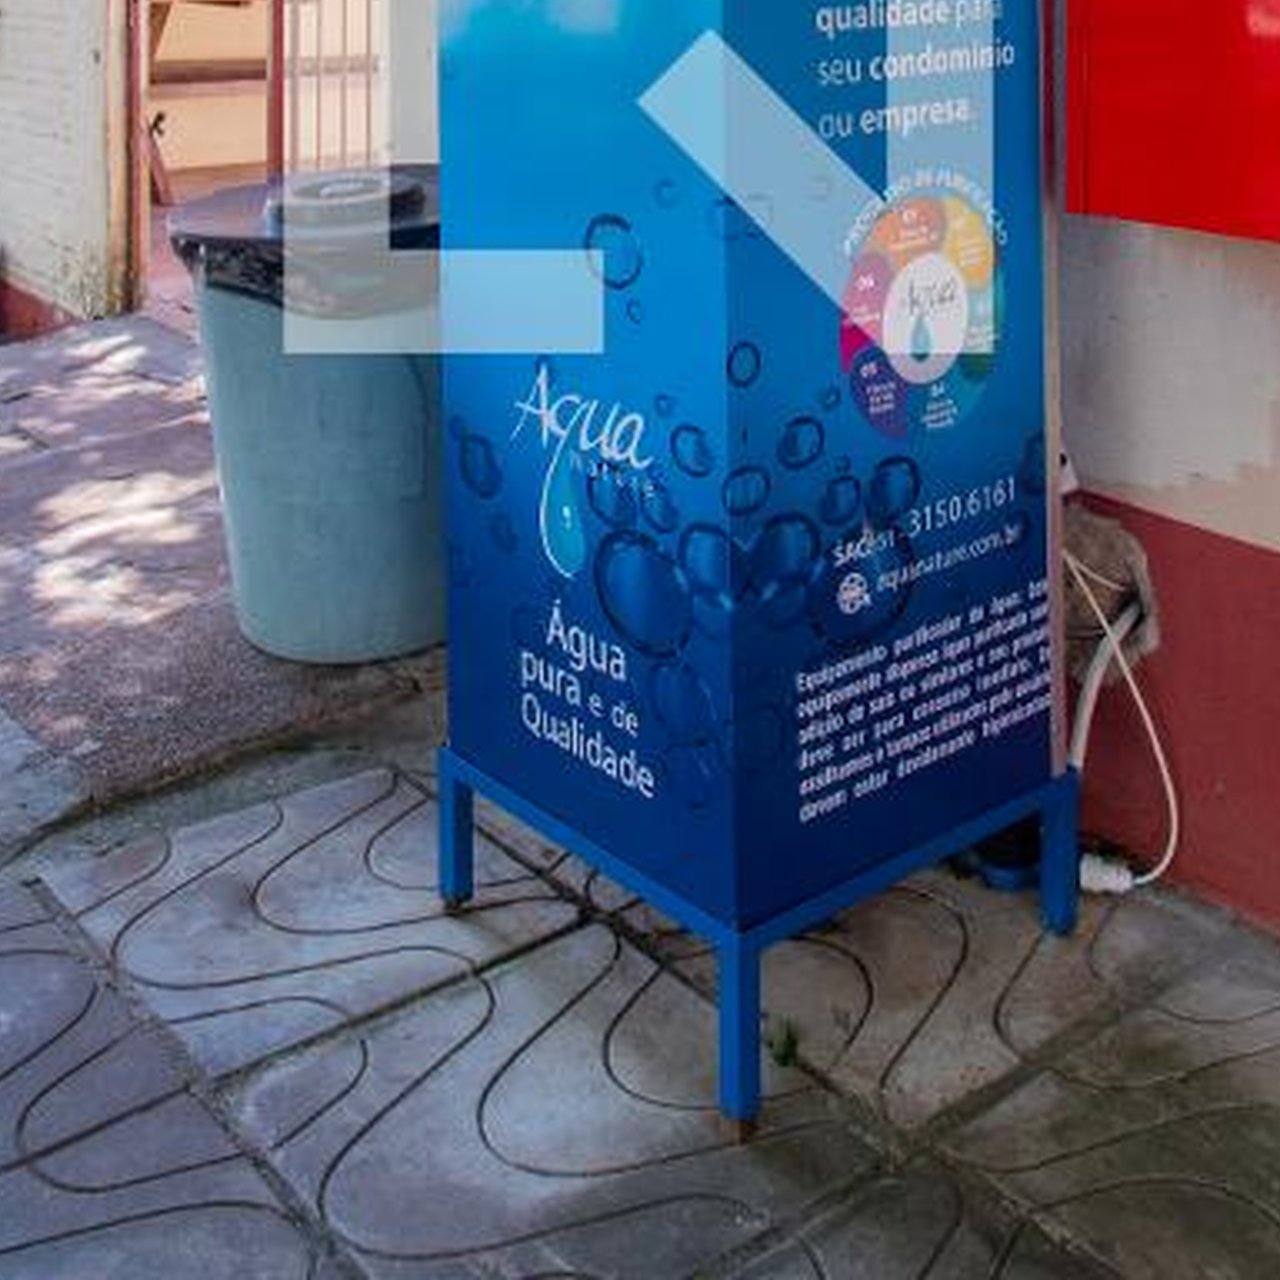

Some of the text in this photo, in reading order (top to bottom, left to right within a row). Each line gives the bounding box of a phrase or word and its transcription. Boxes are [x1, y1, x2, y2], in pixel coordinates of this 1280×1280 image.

[819, 58, 861, 86] seu
[819, 113, 852, 138] ou
[908, 477, 1016, 538] 3150.6161
[546, 598, 626, 682] Água
[522, 651, 639, 738] pura e de
[522, 692, 654, 799] Qualidade
